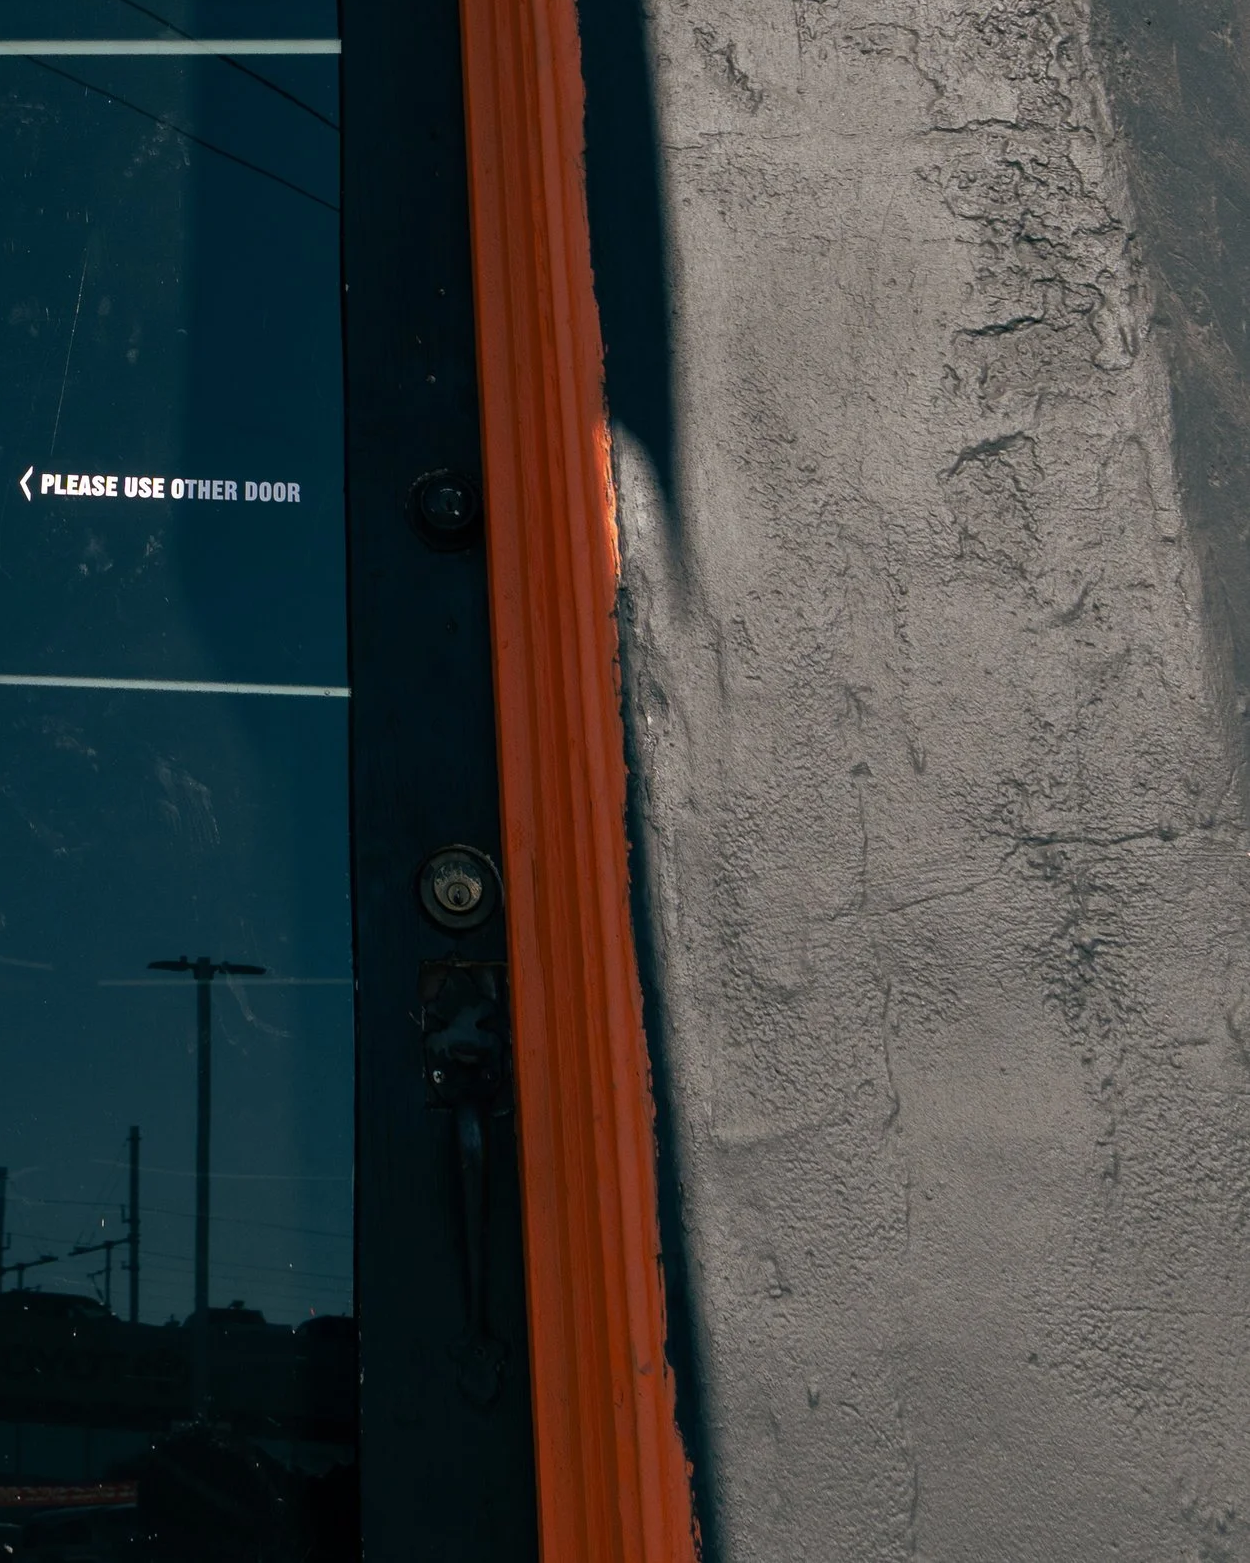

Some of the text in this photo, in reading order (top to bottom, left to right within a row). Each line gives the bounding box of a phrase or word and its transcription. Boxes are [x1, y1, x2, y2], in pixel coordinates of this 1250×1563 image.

[40, 473, 301, 503] PLEASE USE OTHER DOOR
